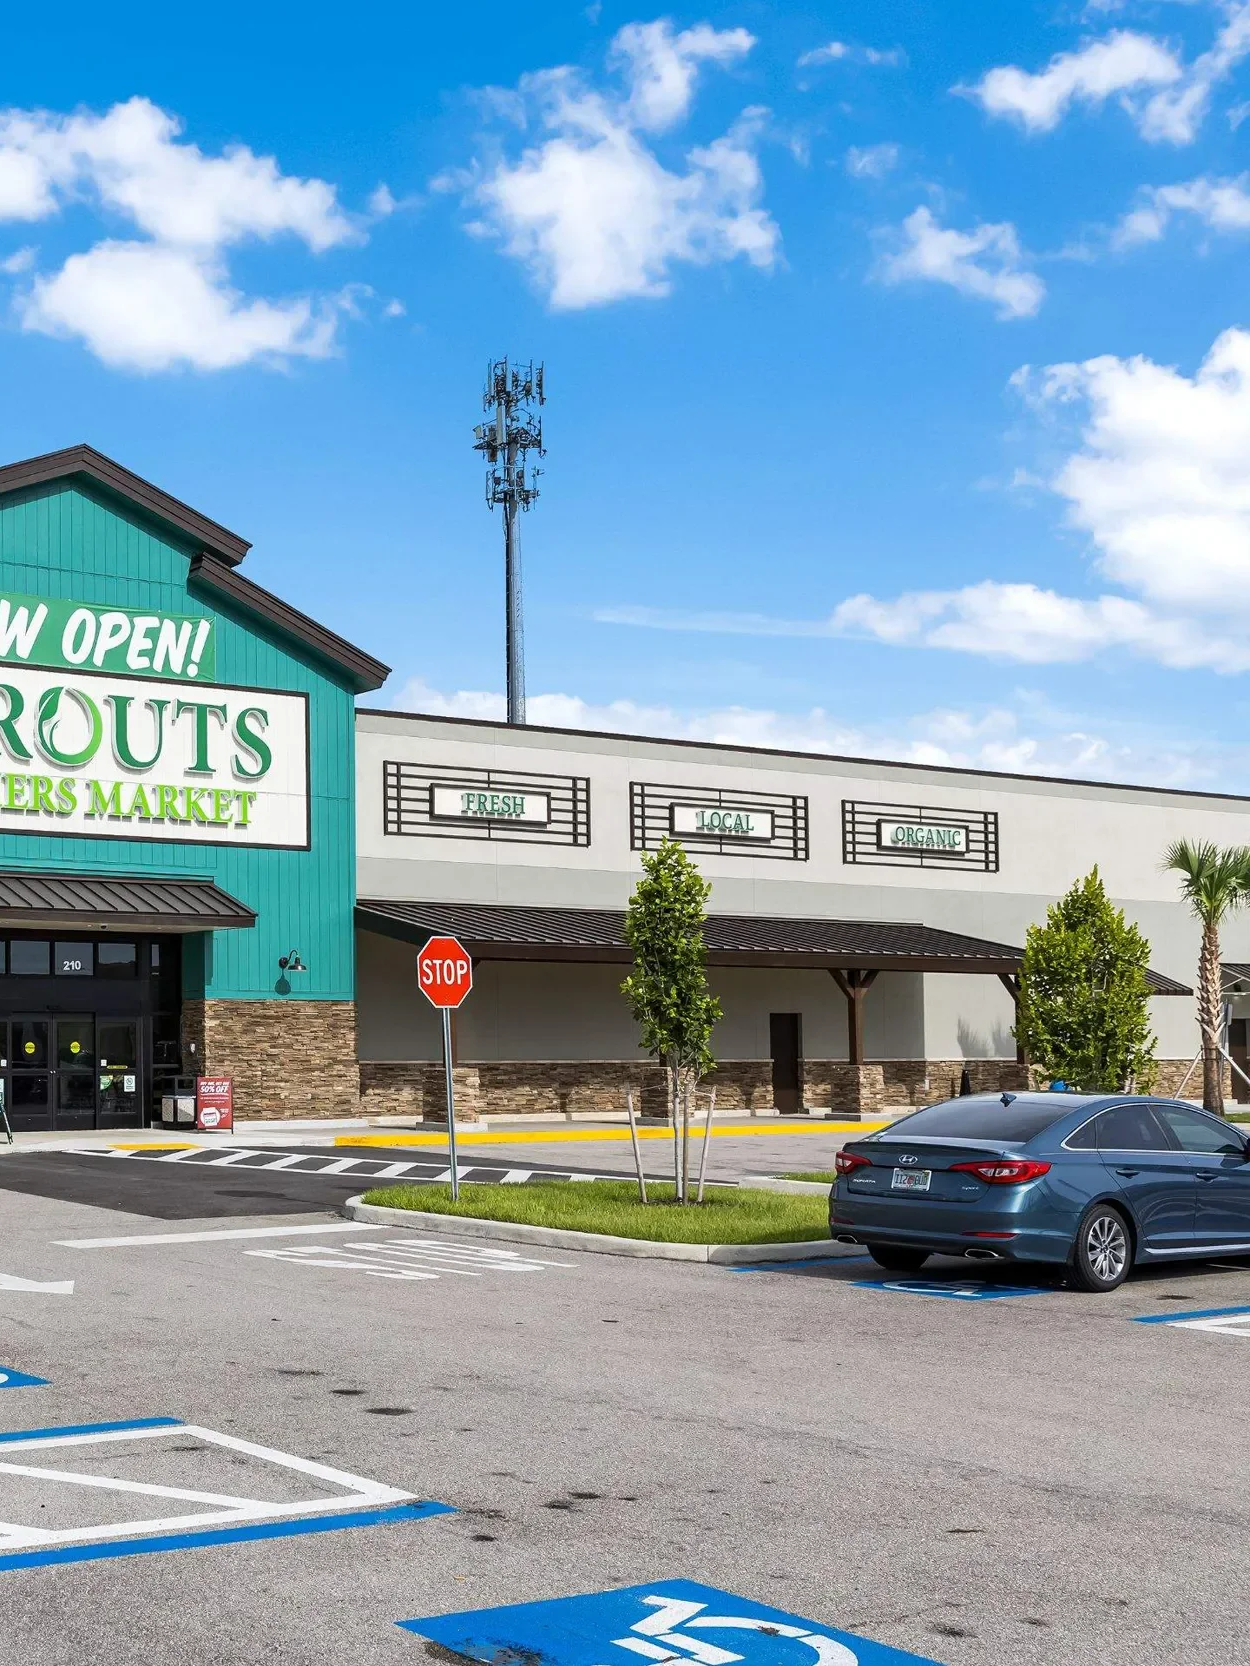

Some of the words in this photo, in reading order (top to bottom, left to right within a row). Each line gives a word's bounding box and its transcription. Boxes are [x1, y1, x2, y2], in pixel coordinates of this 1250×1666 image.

[61, 608, 211, 677] OPEN!
[87, 781, 257, 827] MARKET
[464, 792, 526, 815] FRESH
[699, 810, 754, 832] LOCAL
[894, 826, 962, 846] ORGANIC
[63, 960, 82, 970] 210
[422, 958, 468, 985] STOP
